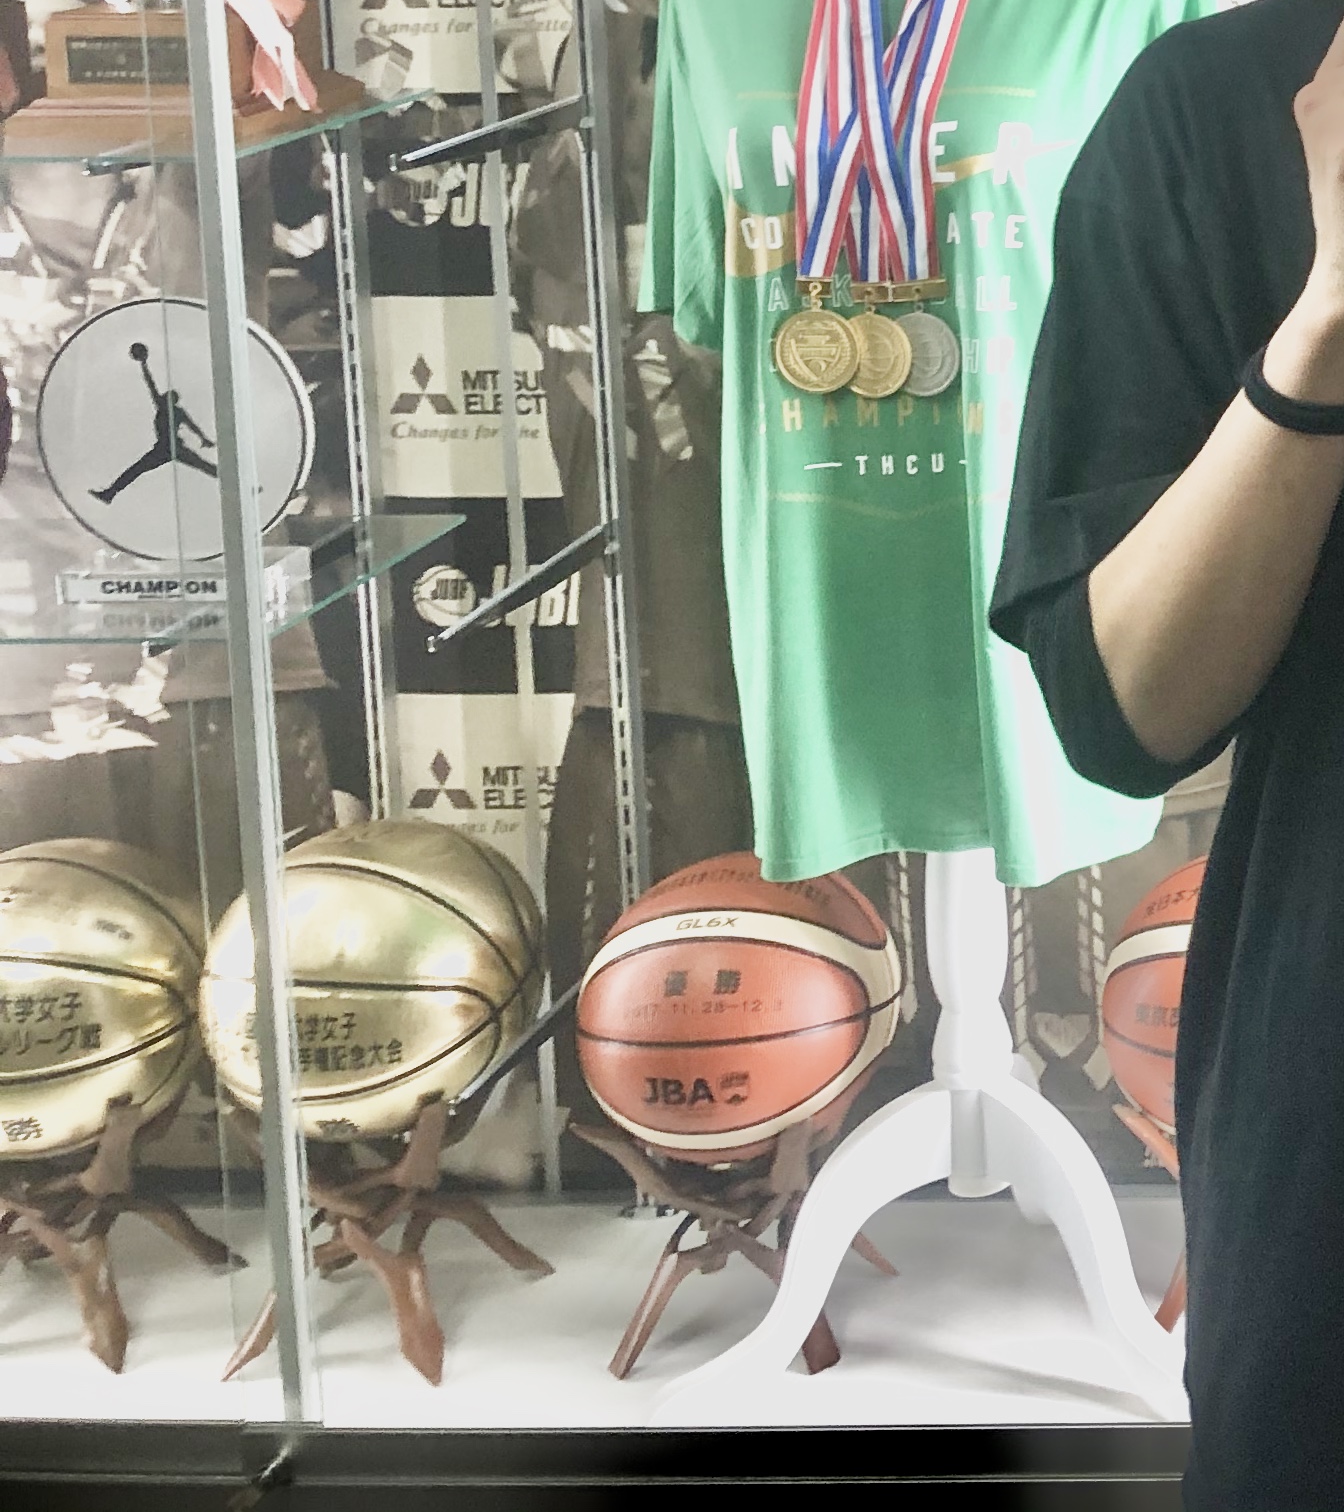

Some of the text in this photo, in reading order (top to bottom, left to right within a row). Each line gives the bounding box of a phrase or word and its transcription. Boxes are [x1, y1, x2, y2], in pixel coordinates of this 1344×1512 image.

[728, 120, 1034, 190] INER
[99, 580, 218, 595] CHAMPON
[676, 916, 739, 931] GL6X
[642, 1077, 718, 1106] JBA
